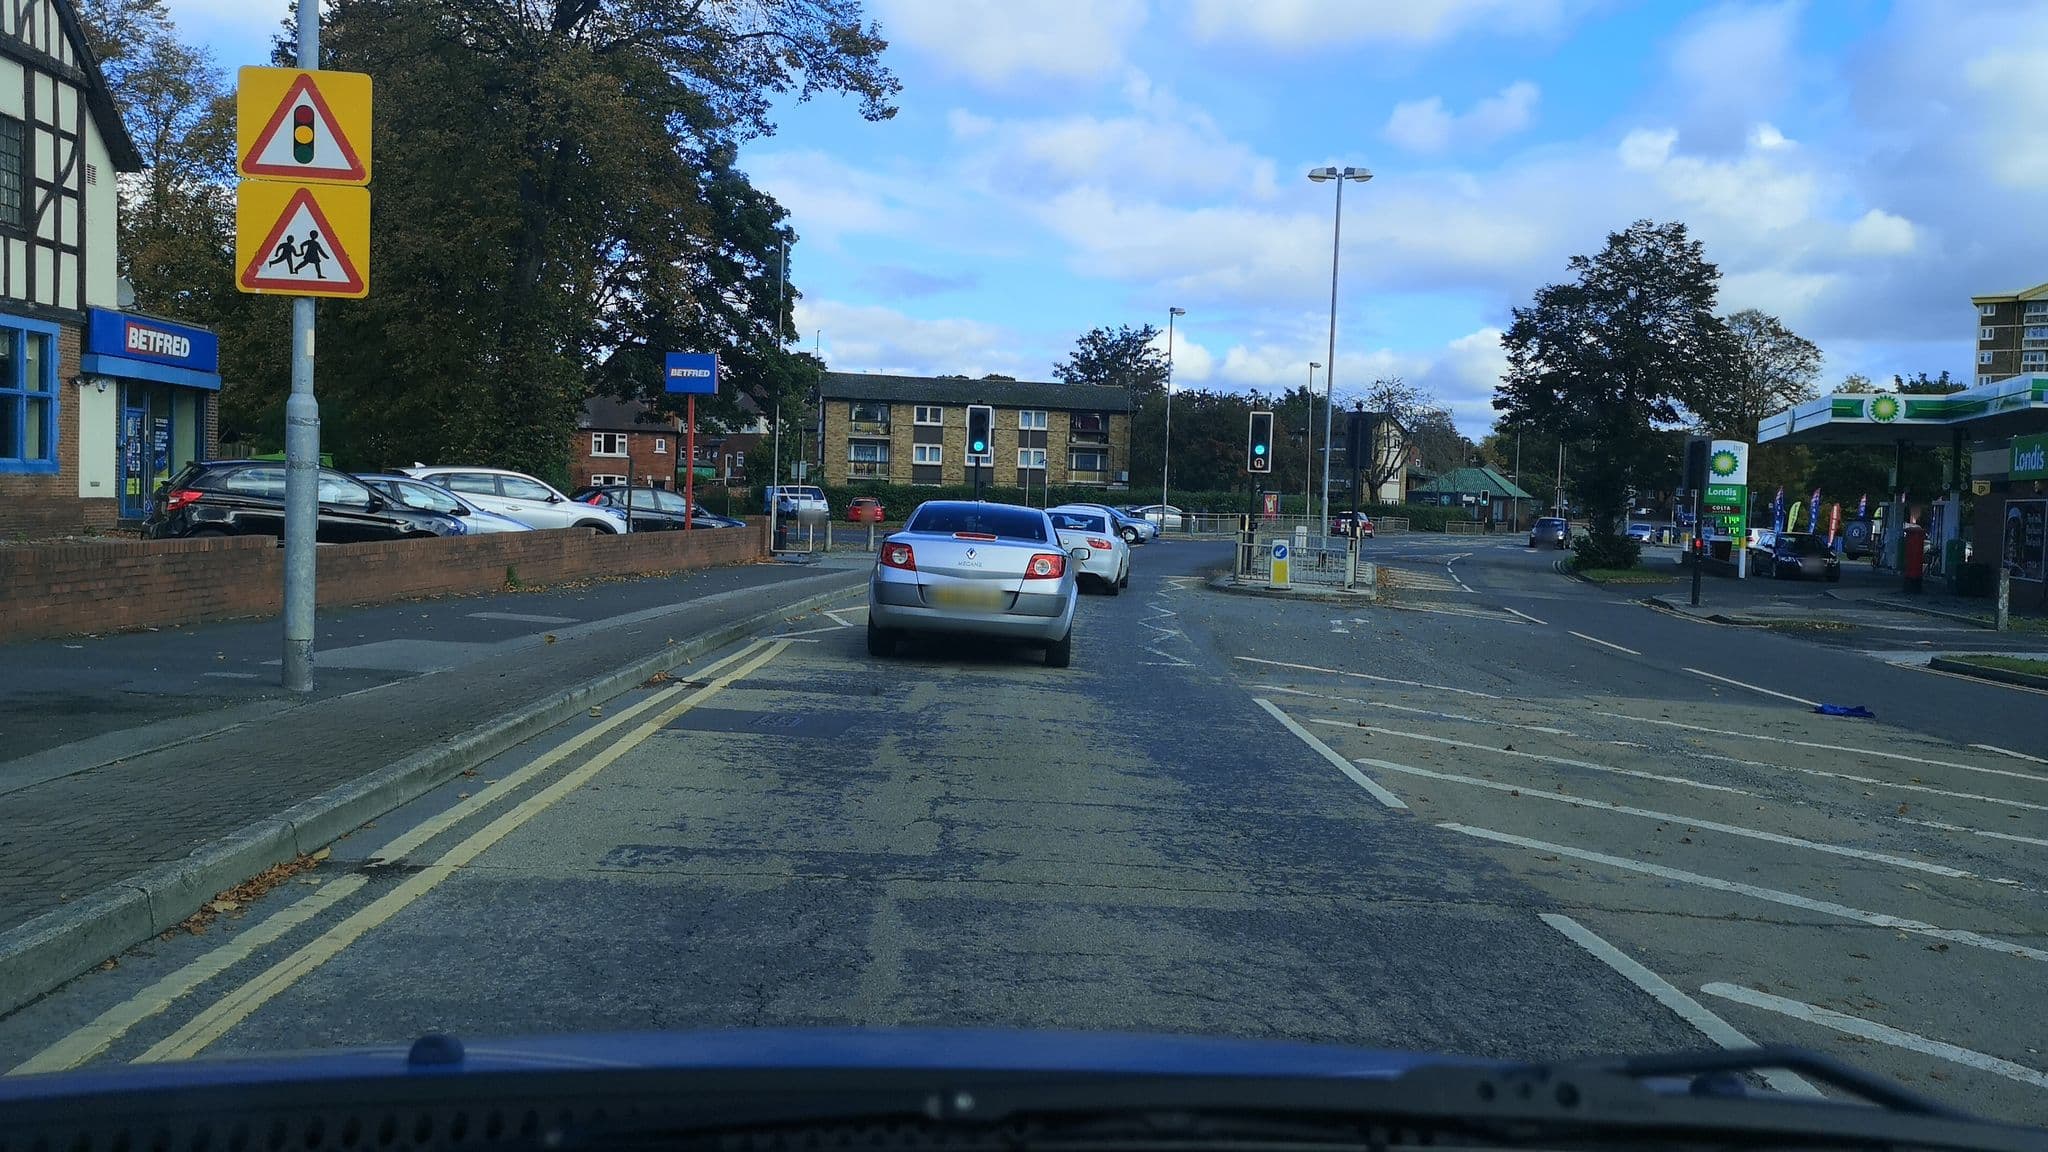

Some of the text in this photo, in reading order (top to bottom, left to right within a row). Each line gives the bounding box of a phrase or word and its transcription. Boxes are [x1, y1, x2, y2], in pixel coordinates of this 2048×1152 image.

[128, 326, 190, 358] BETFRED
[671, 368, 711, 378] BETFRED
[2014, 443, 2045, 471] Londis
[1708, 487, 1737, 496] Londis
